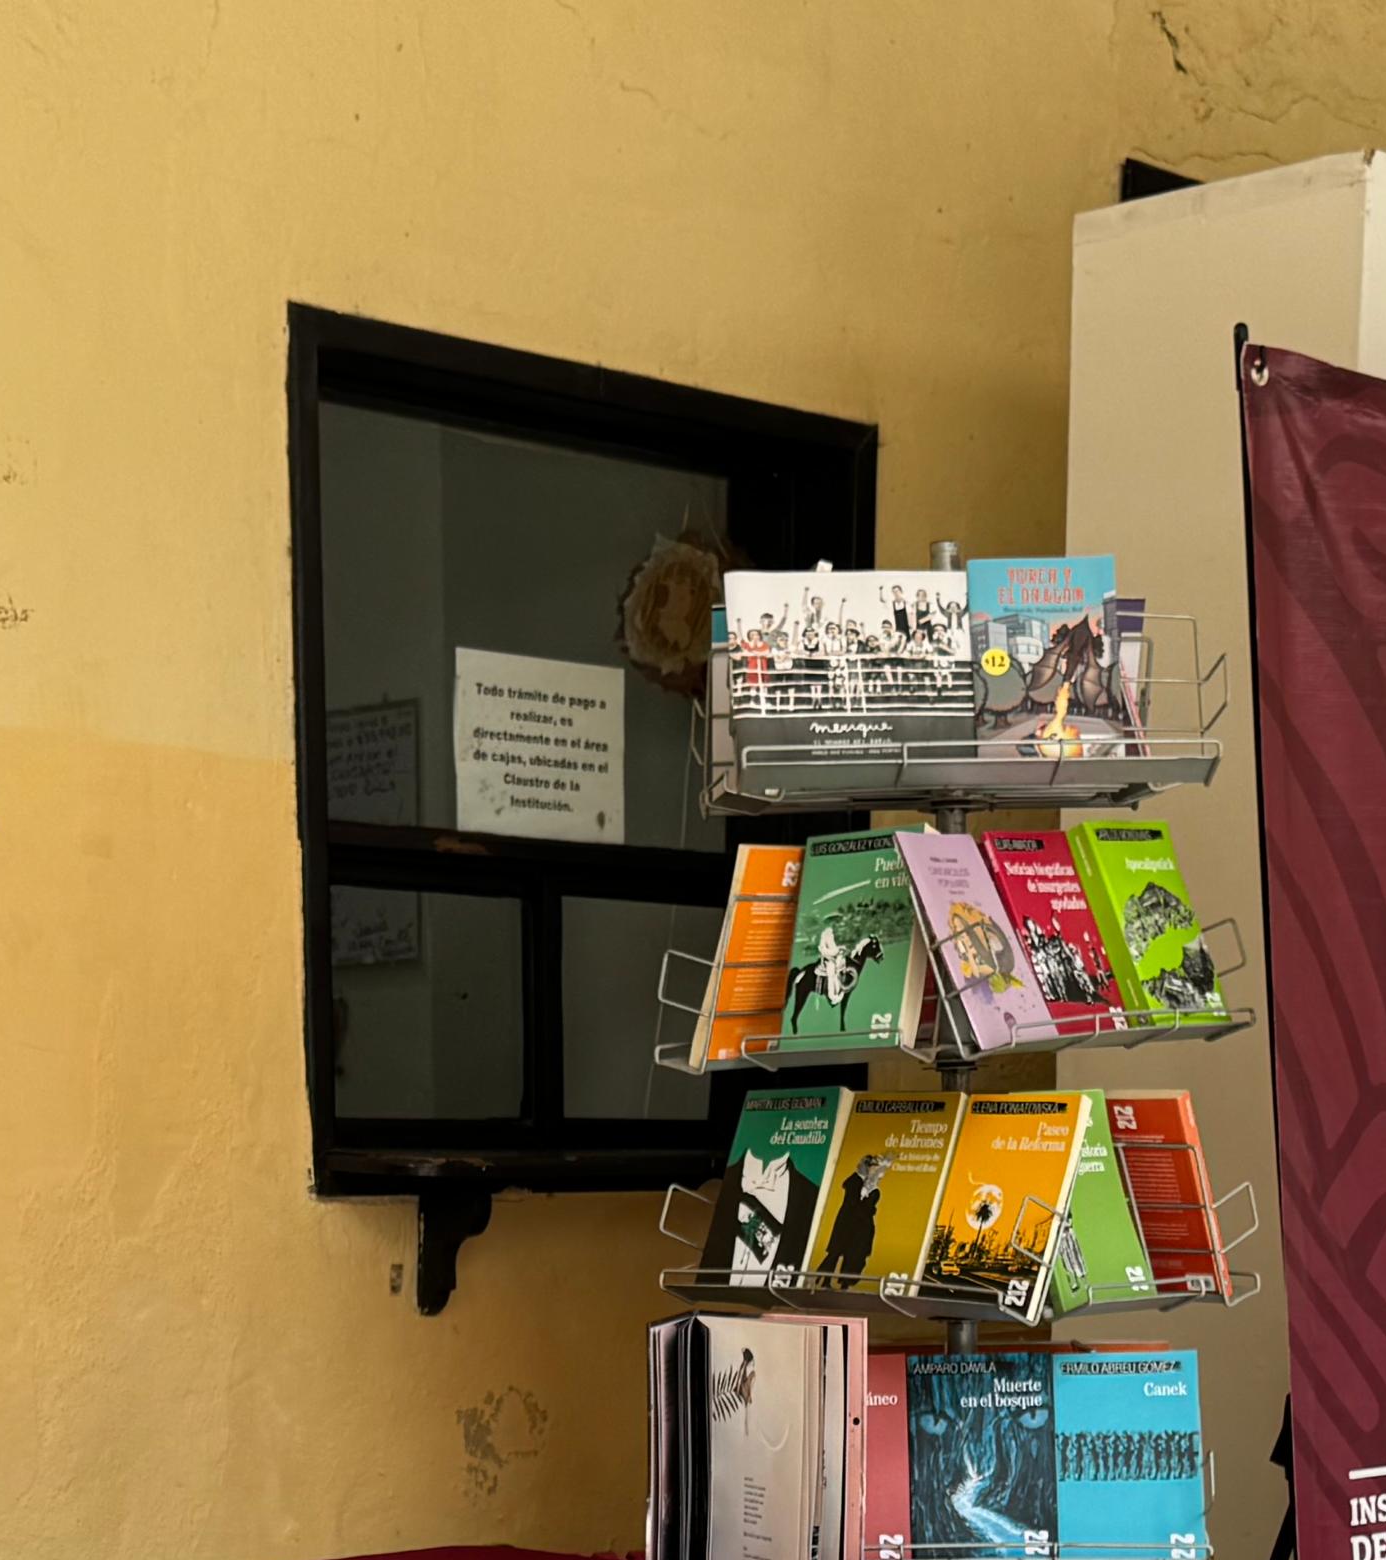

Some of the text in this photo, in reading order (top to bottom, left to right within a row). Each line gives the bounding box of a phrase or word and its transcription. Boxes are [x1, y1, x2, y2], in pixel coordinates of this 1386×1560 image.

[476, 682, 606, 710] Todo trámite de pago a
[510, 711, 573, 727] realizar, es
[473, 727, 608, 752] directamente en el área
[473, 749, 609, 773] de cajas, ubicadas en el
[504, 773, 580, 792] Claustro de la
[510, 795, 574, 812] Institución.
[875, 878, 889, 889] en
[780, 1116, 829, 1131] La sombra
[910, 1120, 948, 1137] Tiempo
[1037, 1121, 1069, 1137] Paseo
[769, 1131, 826, 1145] del Caudillo
[884, 1133, 944, 1148] de ladrones
[991, 1136, 1066, 1152] de la Reforma
[913, 1358, 997, 1375] AMPARO DÁVILA
[993, 1378, 1042, 1394] Muerte
[1144, 1381, 1188, 1398] Canek
[960, 1393, 1043, 1410] en el bosque
